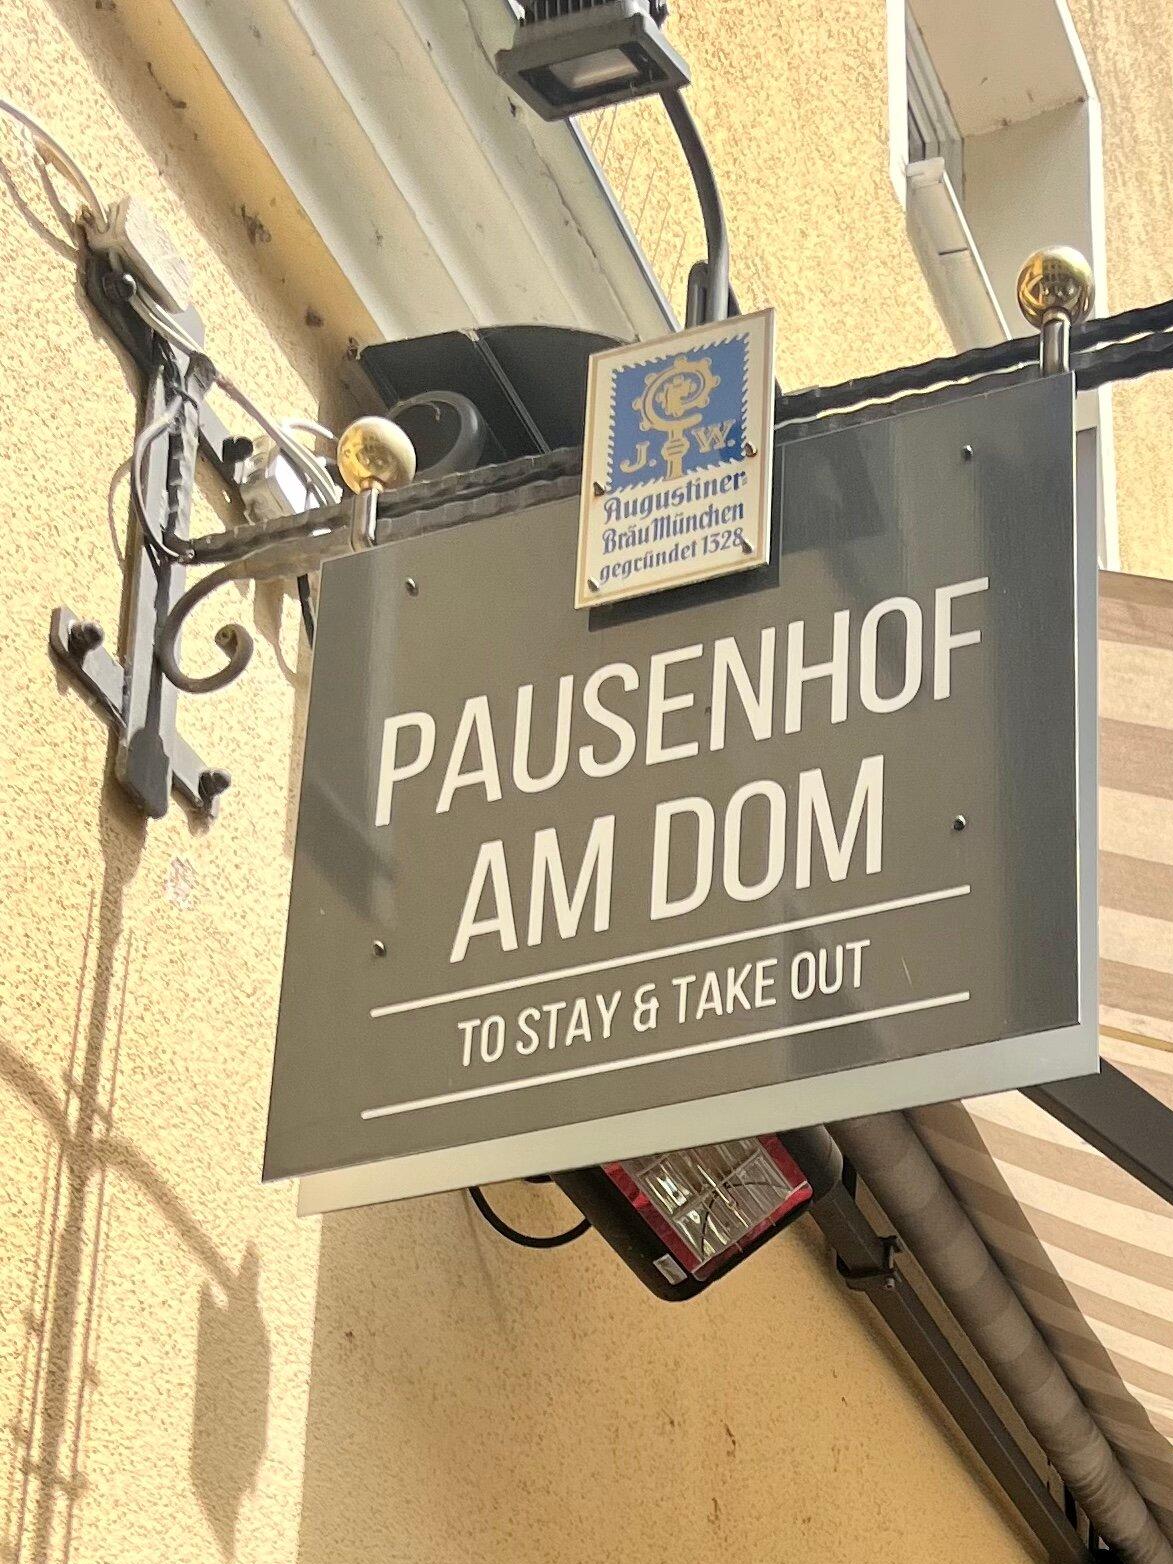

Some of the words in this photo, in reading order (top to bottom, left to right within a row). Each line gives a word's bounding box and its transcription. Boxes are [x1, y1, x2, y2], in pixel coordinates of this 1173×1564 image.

[599, 541, 697, 586] gegründet
[374, 576, 990, 829] PAUSENHOF
[449, 814, 616, 964] AM
[647, 754, 886, 922] DOM
[458, 1016, 504, 1068] TO
[515, 988, 618, 1057] STAY
[631, 983, 661, 1033] &
[671, 957, 778, 1024] TAKE
[791, 939, 871, 1000] OUT
